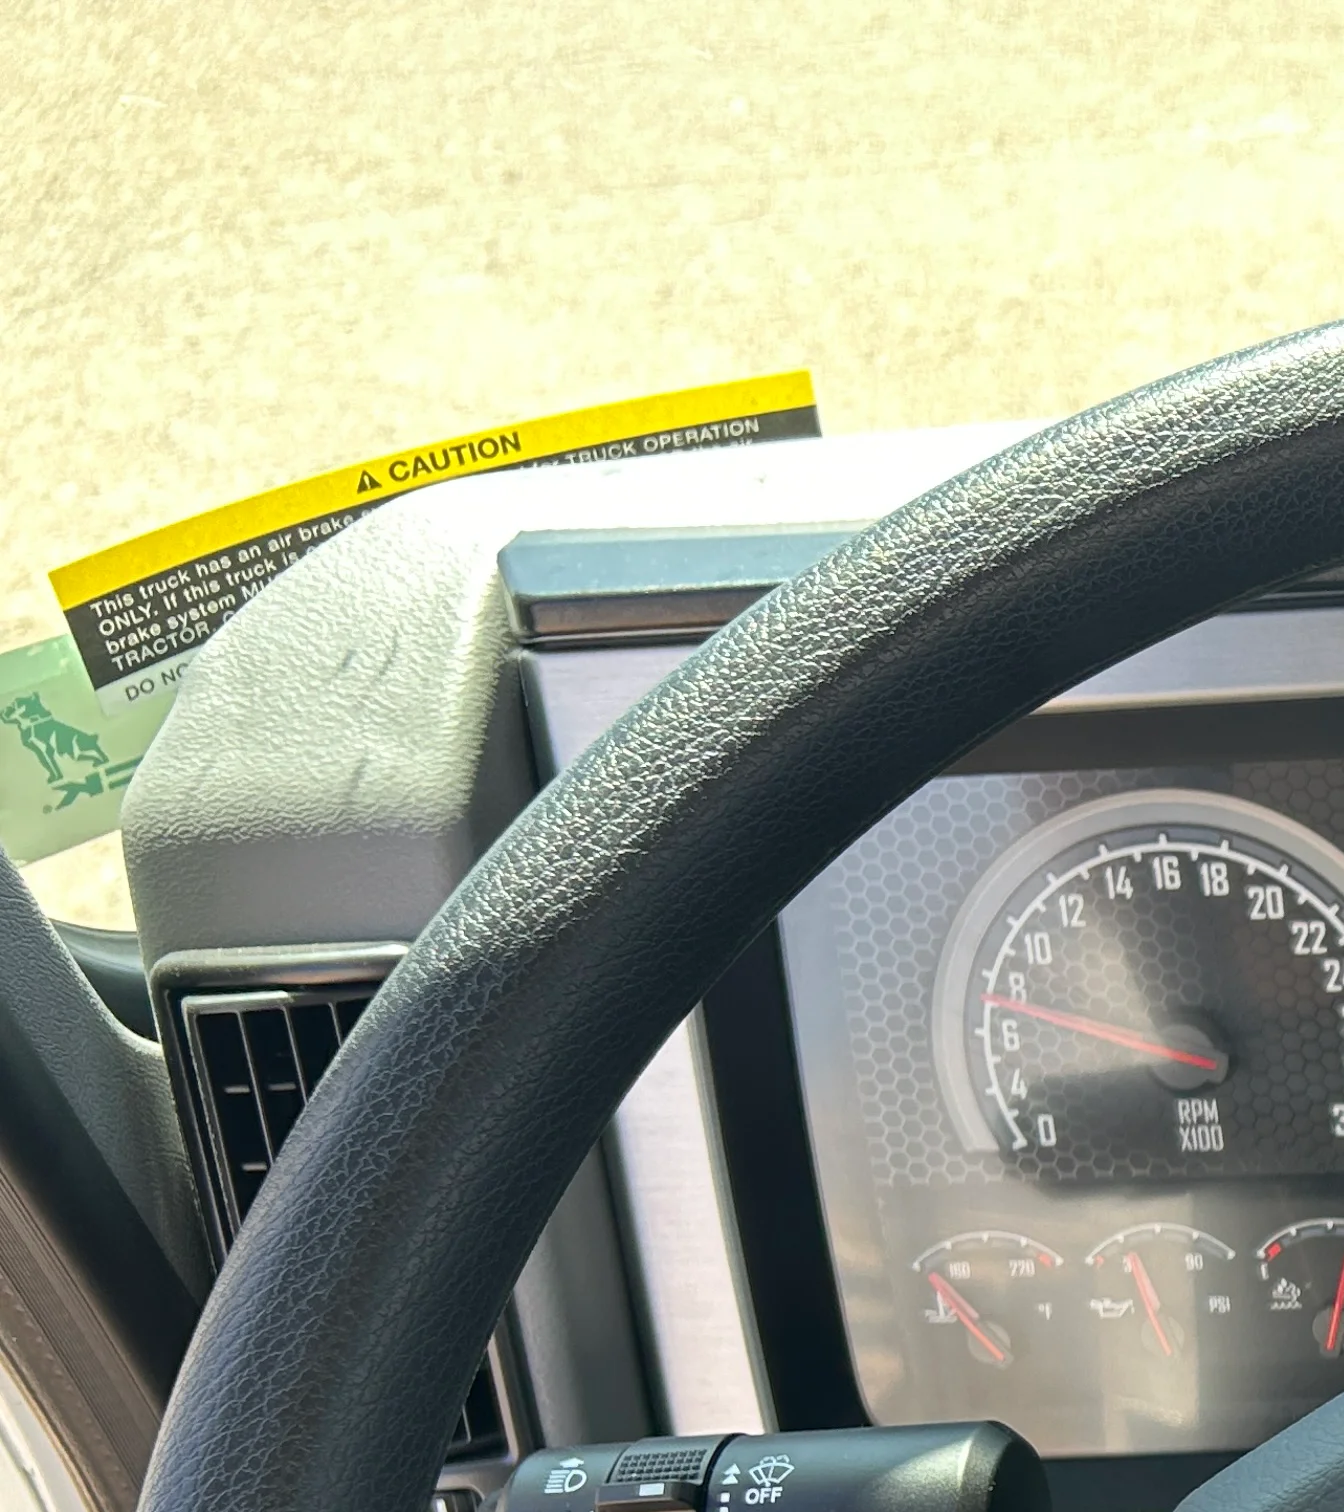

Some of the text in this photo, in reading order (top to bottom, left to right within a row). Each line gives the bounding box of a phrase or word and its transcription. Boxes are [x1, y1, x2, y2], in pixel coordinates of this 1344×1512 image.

[643, 417, 760, 453] OPERATION
[388, 431, 523, 483] CAUTION
[90, 591, 134, 618] This
[138, 569, 192, 599] truck
[194, 552, 232, 579] has
[238, 544, 262, 564] an
[267, 531, 292, 553] air
[98, 602, 158, 636] ONLY.
[163, 595, 178, 611] If
[183, 579, 220, 604] this
[225, 558, 277, 587] truck
[105, 623, 161, 654] brake
[167, 593, 236, 630] system
[111, 621, 216, 671] TRACTOR.
[125, 678, 155, 702] DO
[1106, 866, 1134, 899] 14
[1153, 856, 1181, 890] 16
[1200, 861, 1230, 897] 18
[1061, 894, 1086, 928] 12
[1248, 885, 1285, 920] 20
[1025, 931, 1052, 966] 10
[1291, 921, 1328, 956] 22
[1009, 972, 1027, 1002] 8
[1002, 1020, 1020, 1051] 6
[1010, 1069, 1028, 1099] 4
[1178, 1098, 1220, 1124] RPM
[1037, 1114, 1056, 1147] 0
[1179, 1125, 1224, 1152] X100
[745, 1486, 782, 1505] OFF
